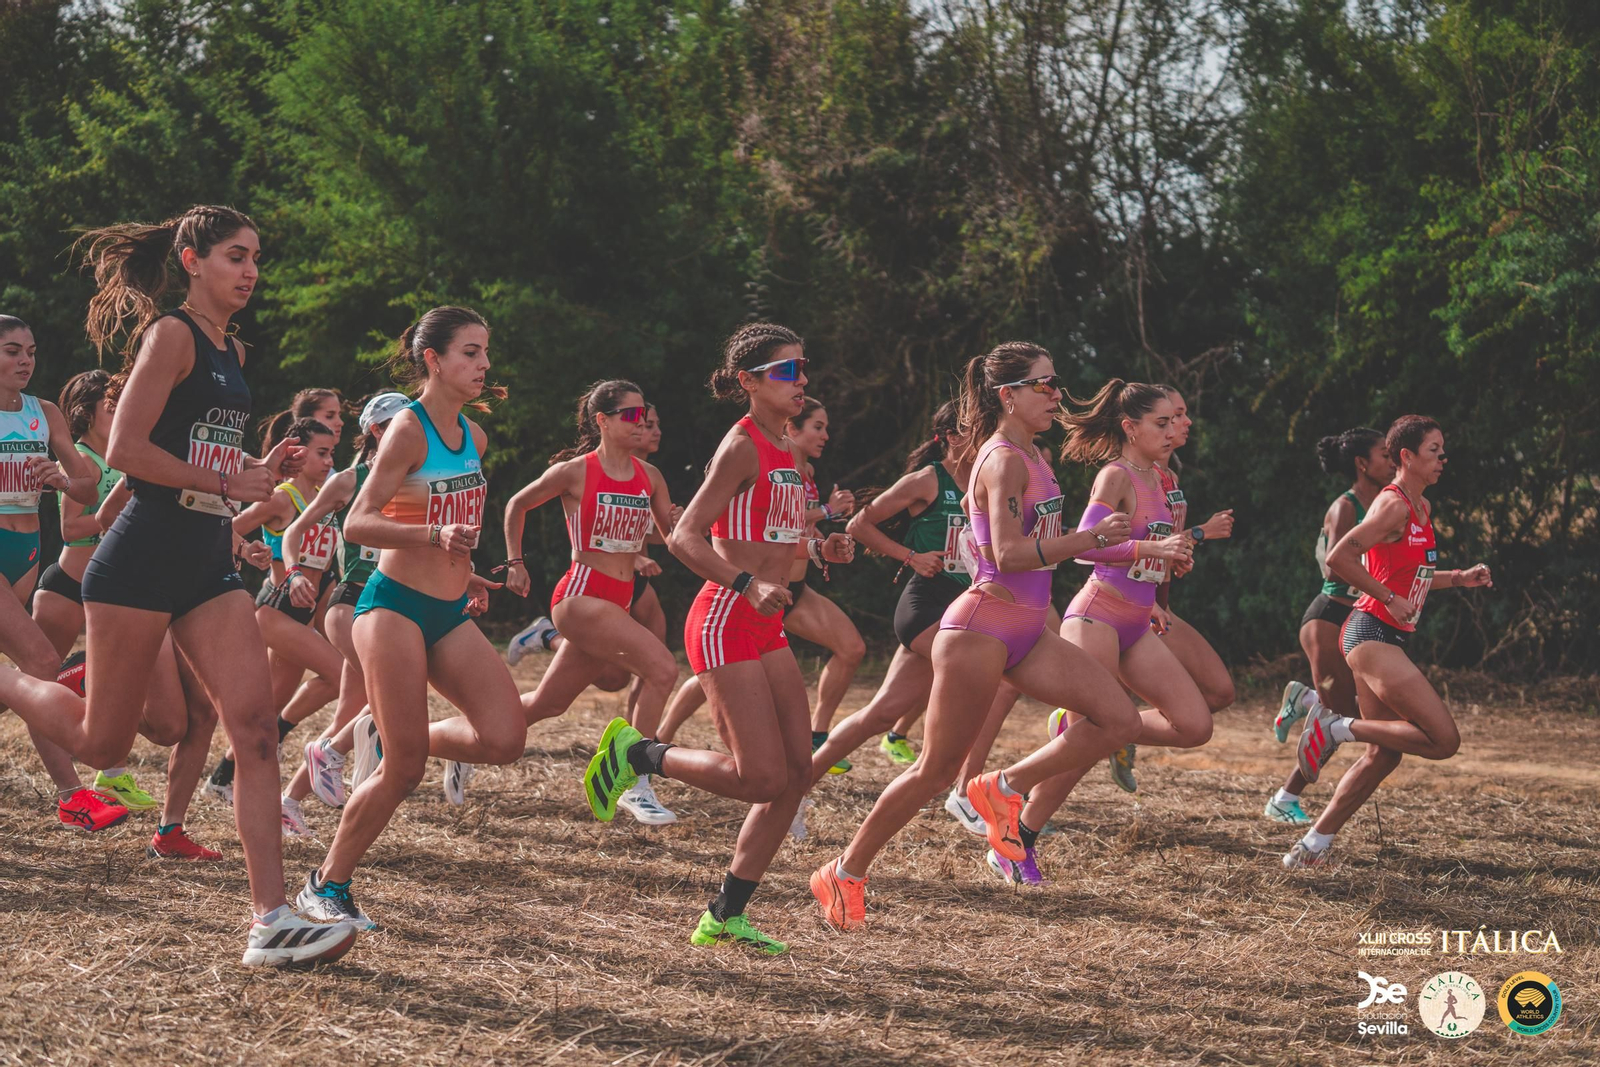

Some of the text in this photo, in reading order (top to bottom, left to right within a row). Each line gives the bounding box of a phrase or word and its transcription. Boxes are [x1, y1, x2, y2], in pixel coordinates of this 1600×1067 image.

[213, 430, 242, 445] ITÁLIC
[1, 441, 36, 451] ITÁLICA
[191, 440, 243, 475] VICIOS
[451, 476, 477, 490] ITÁLICA
[616, 495, 645, 507] ITÁLICA
[592, 503, 650, 542] BARREIR
